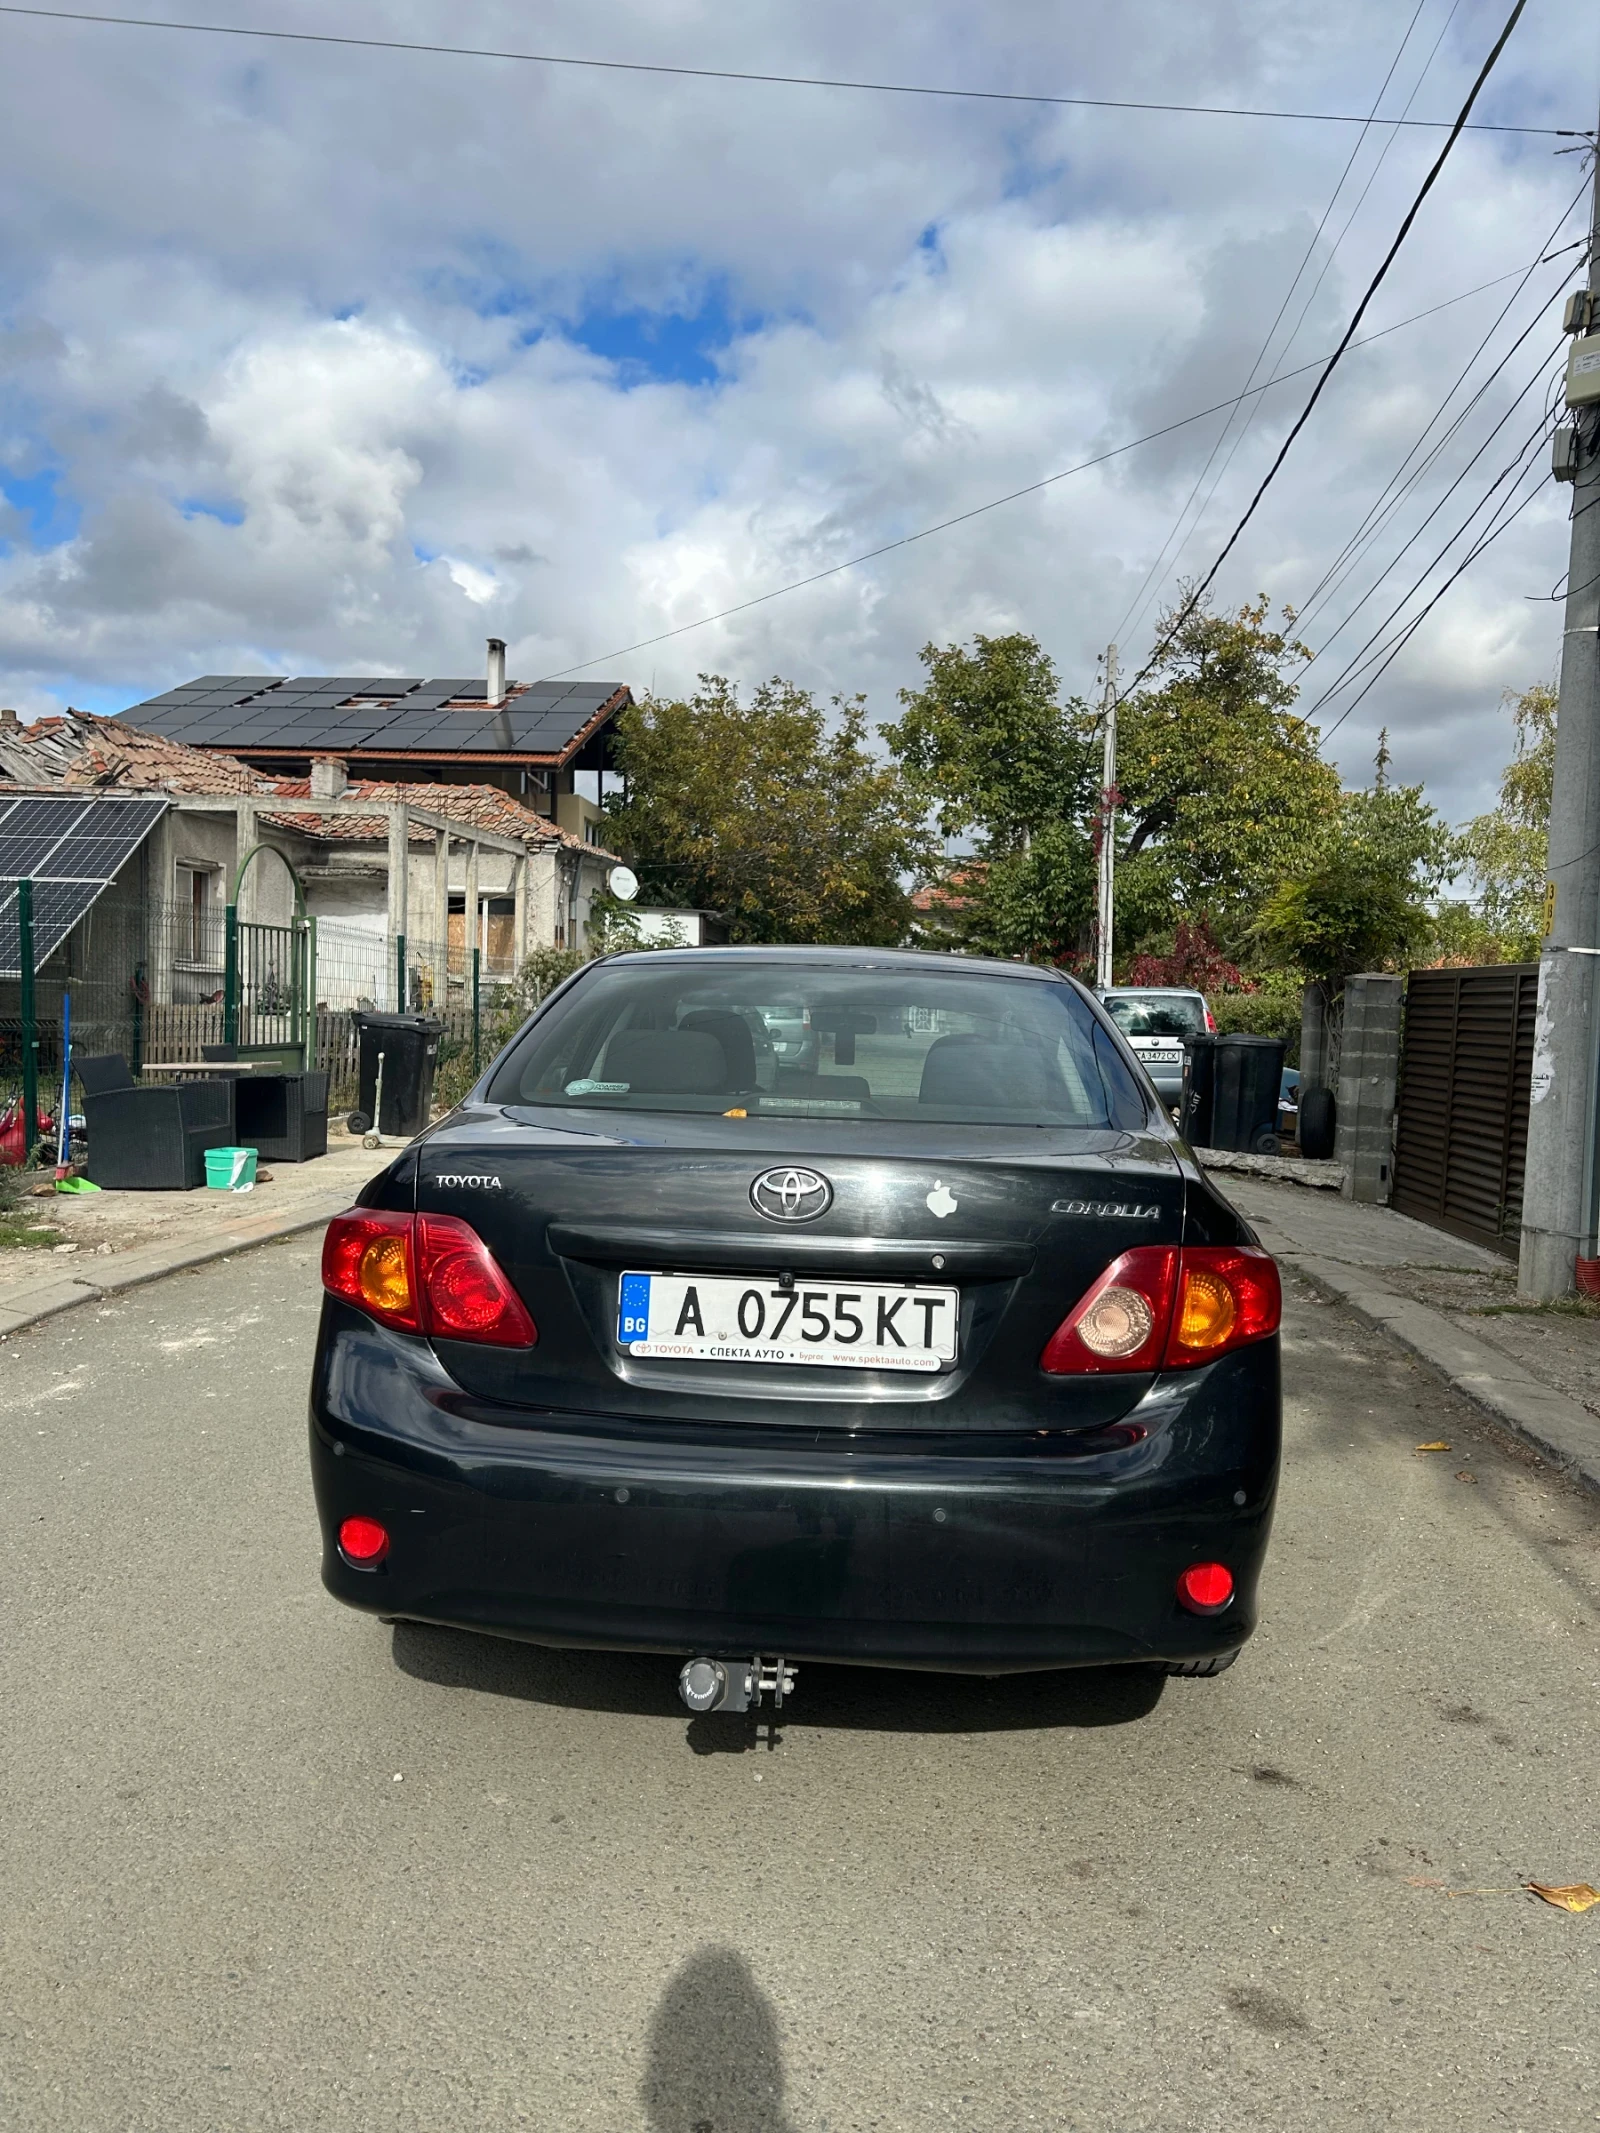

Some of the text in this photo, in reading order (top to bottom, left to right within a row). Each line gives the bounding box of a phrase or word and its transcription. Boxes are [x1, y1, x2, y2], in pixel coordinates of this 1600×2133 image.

[435, 1175, 502, 1190] TOYOTA
[1050, 1199, 1160, 1219] COROLLA
[674, 1285, 705, 1337] A
[624, 1316, 646, 1334] BG
[653, 1345, 694, 1355] TOYOTA
[710, 1347, 751, 1358] СПЕКТА
[832, 1352, 935, 1368] www.spektaauto.com
